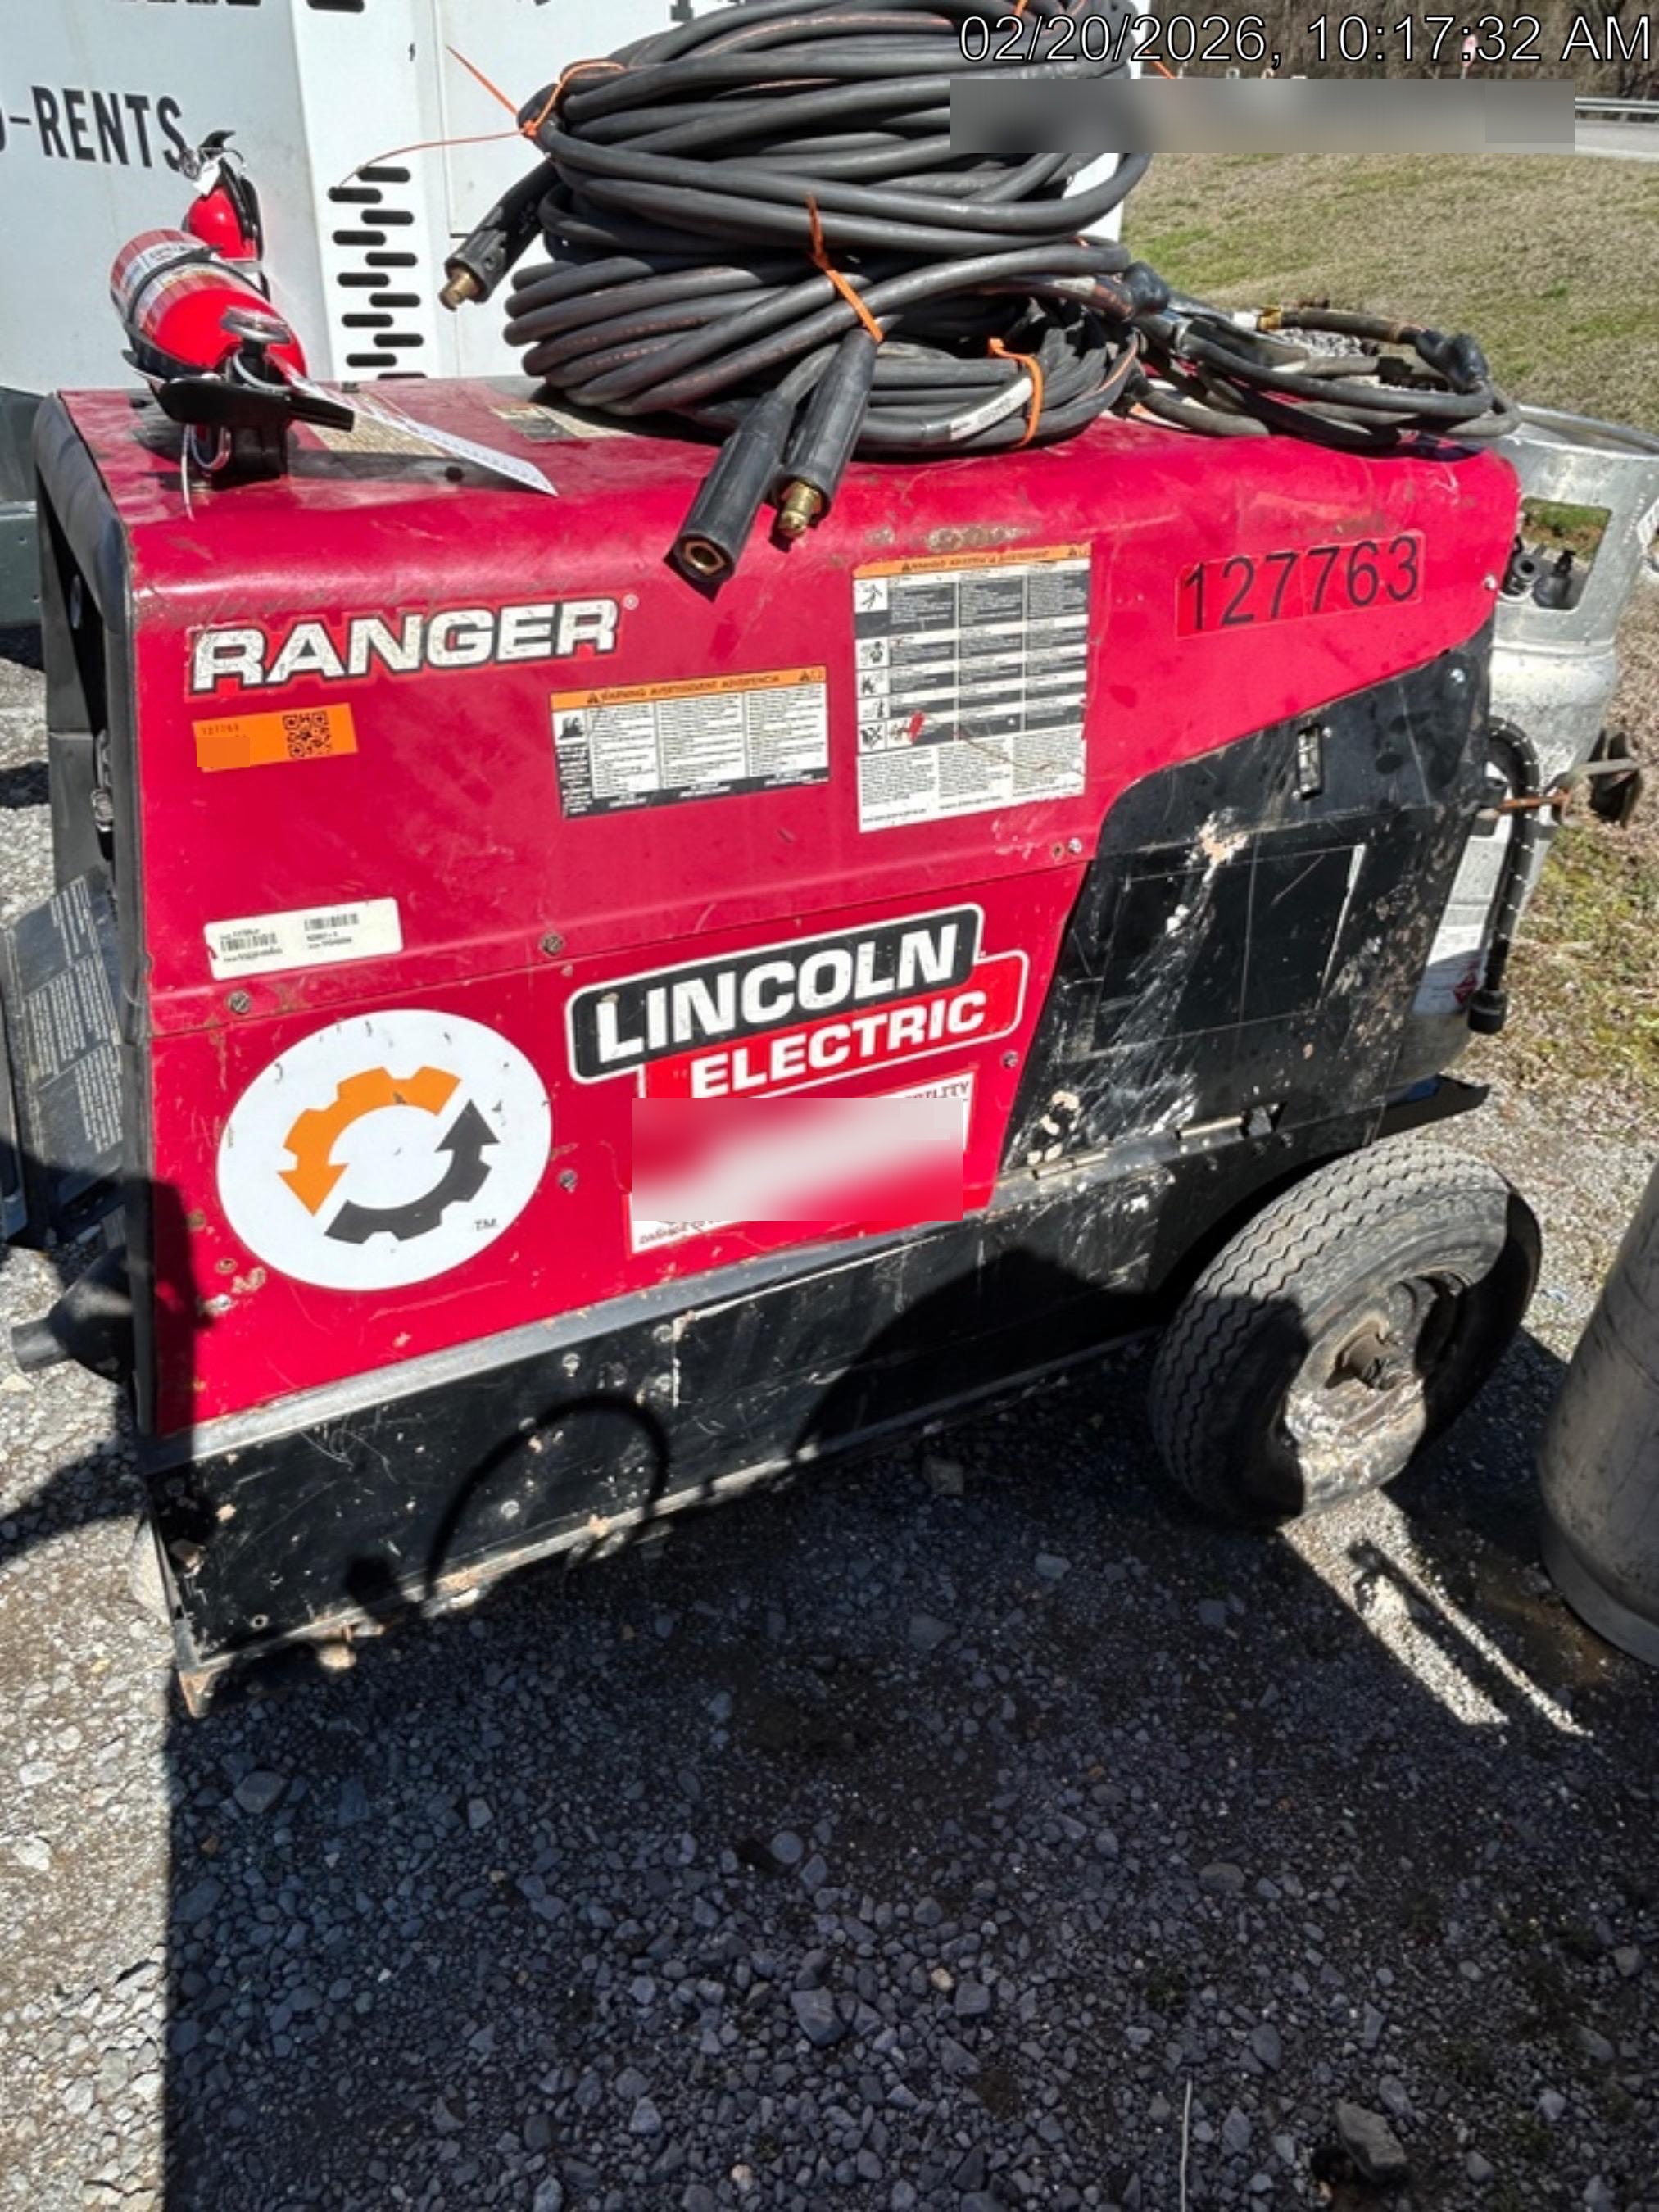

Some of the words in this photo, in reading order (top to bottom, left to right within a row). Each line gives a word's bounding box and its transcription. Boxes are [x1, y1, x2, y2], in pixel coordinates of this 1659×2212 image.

[0, 85, 188, 172] -RENTS
[1184, 535, 1418, 630] 127763
[596, 923, 959, 1063] LINCOLN
[690, 990, 986, 1098] ELECTRIC
